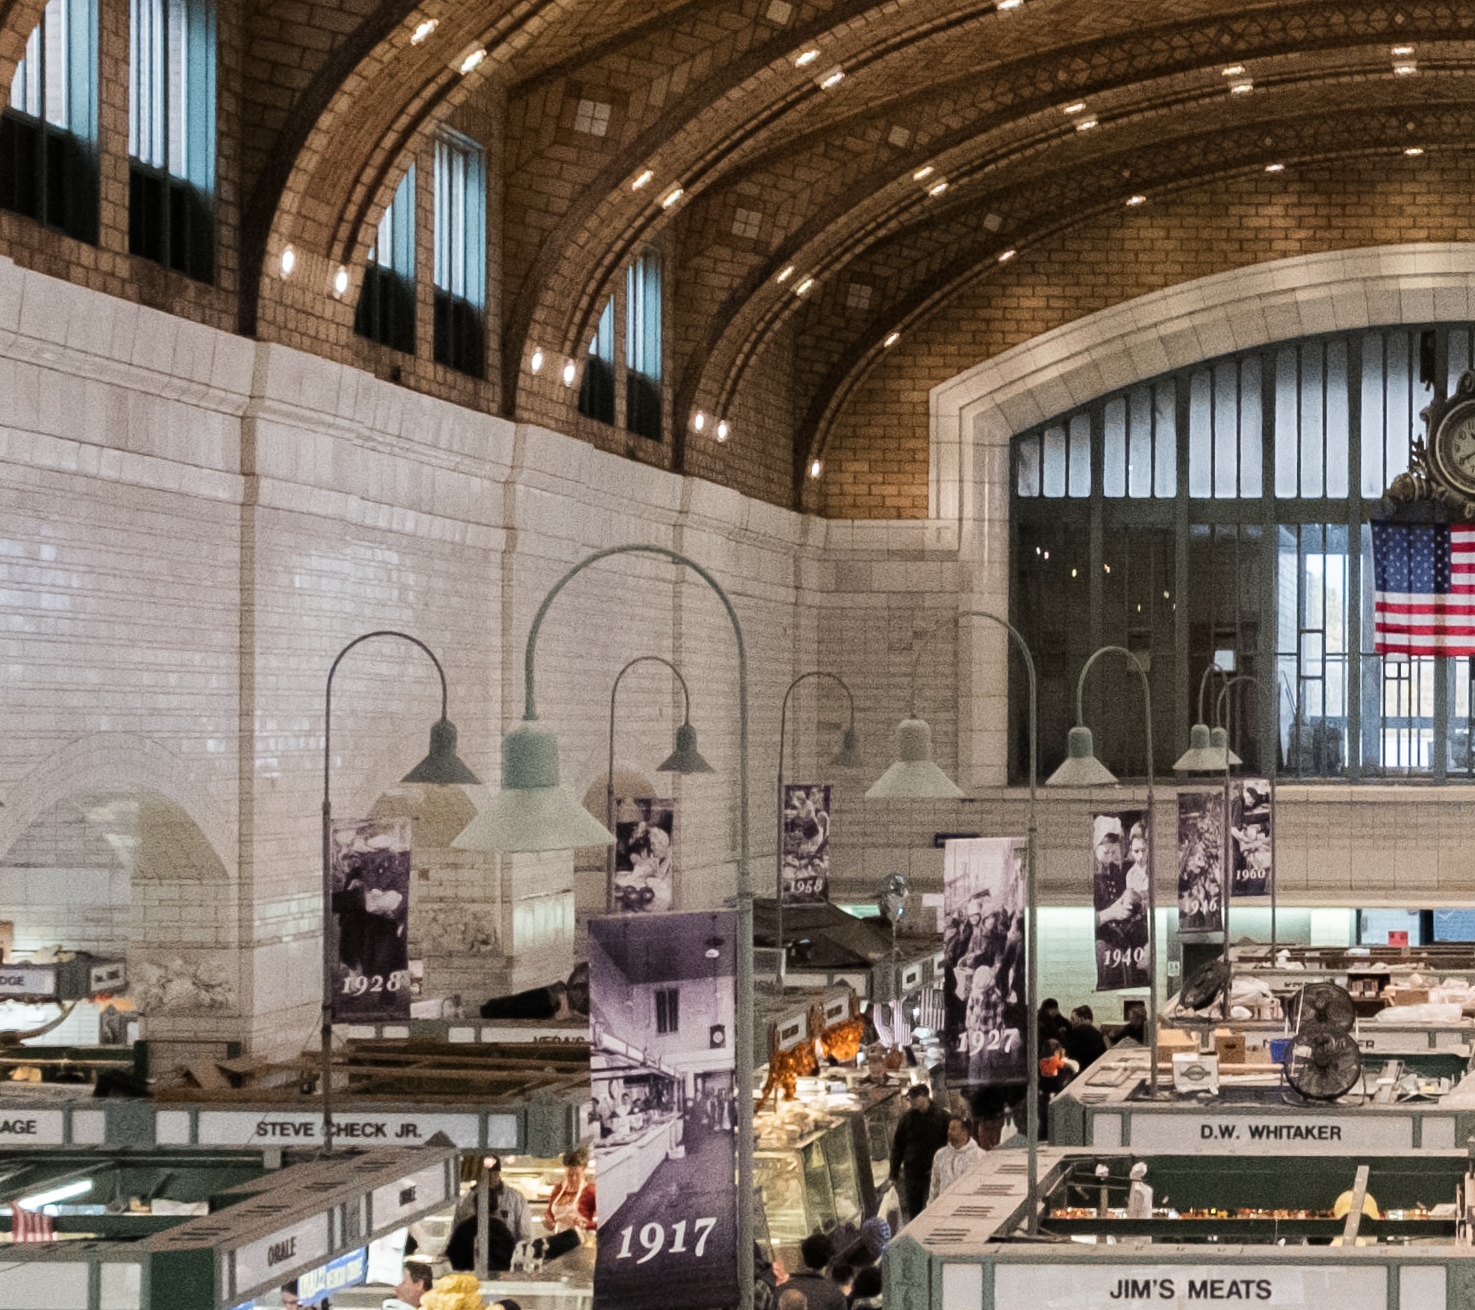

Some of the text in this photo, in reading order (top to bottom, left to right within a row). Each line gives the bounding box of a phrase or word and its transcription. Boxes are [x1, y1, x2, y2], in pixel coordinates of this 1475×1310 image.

[1103, 946, 1144, 969] 1940
[341, 971, 402, 997] 1928
[957, 1025, 1021, 1055] 1927
[256, 1121, 423, 1139] STEVE CHECK JR.
[1200, 1123, 1343, 1143] D.W. WHITAKER
[615, 1216, 717, 1266] 1917
[1109, 1278, 1273, 1301] JIM'S MEATS
